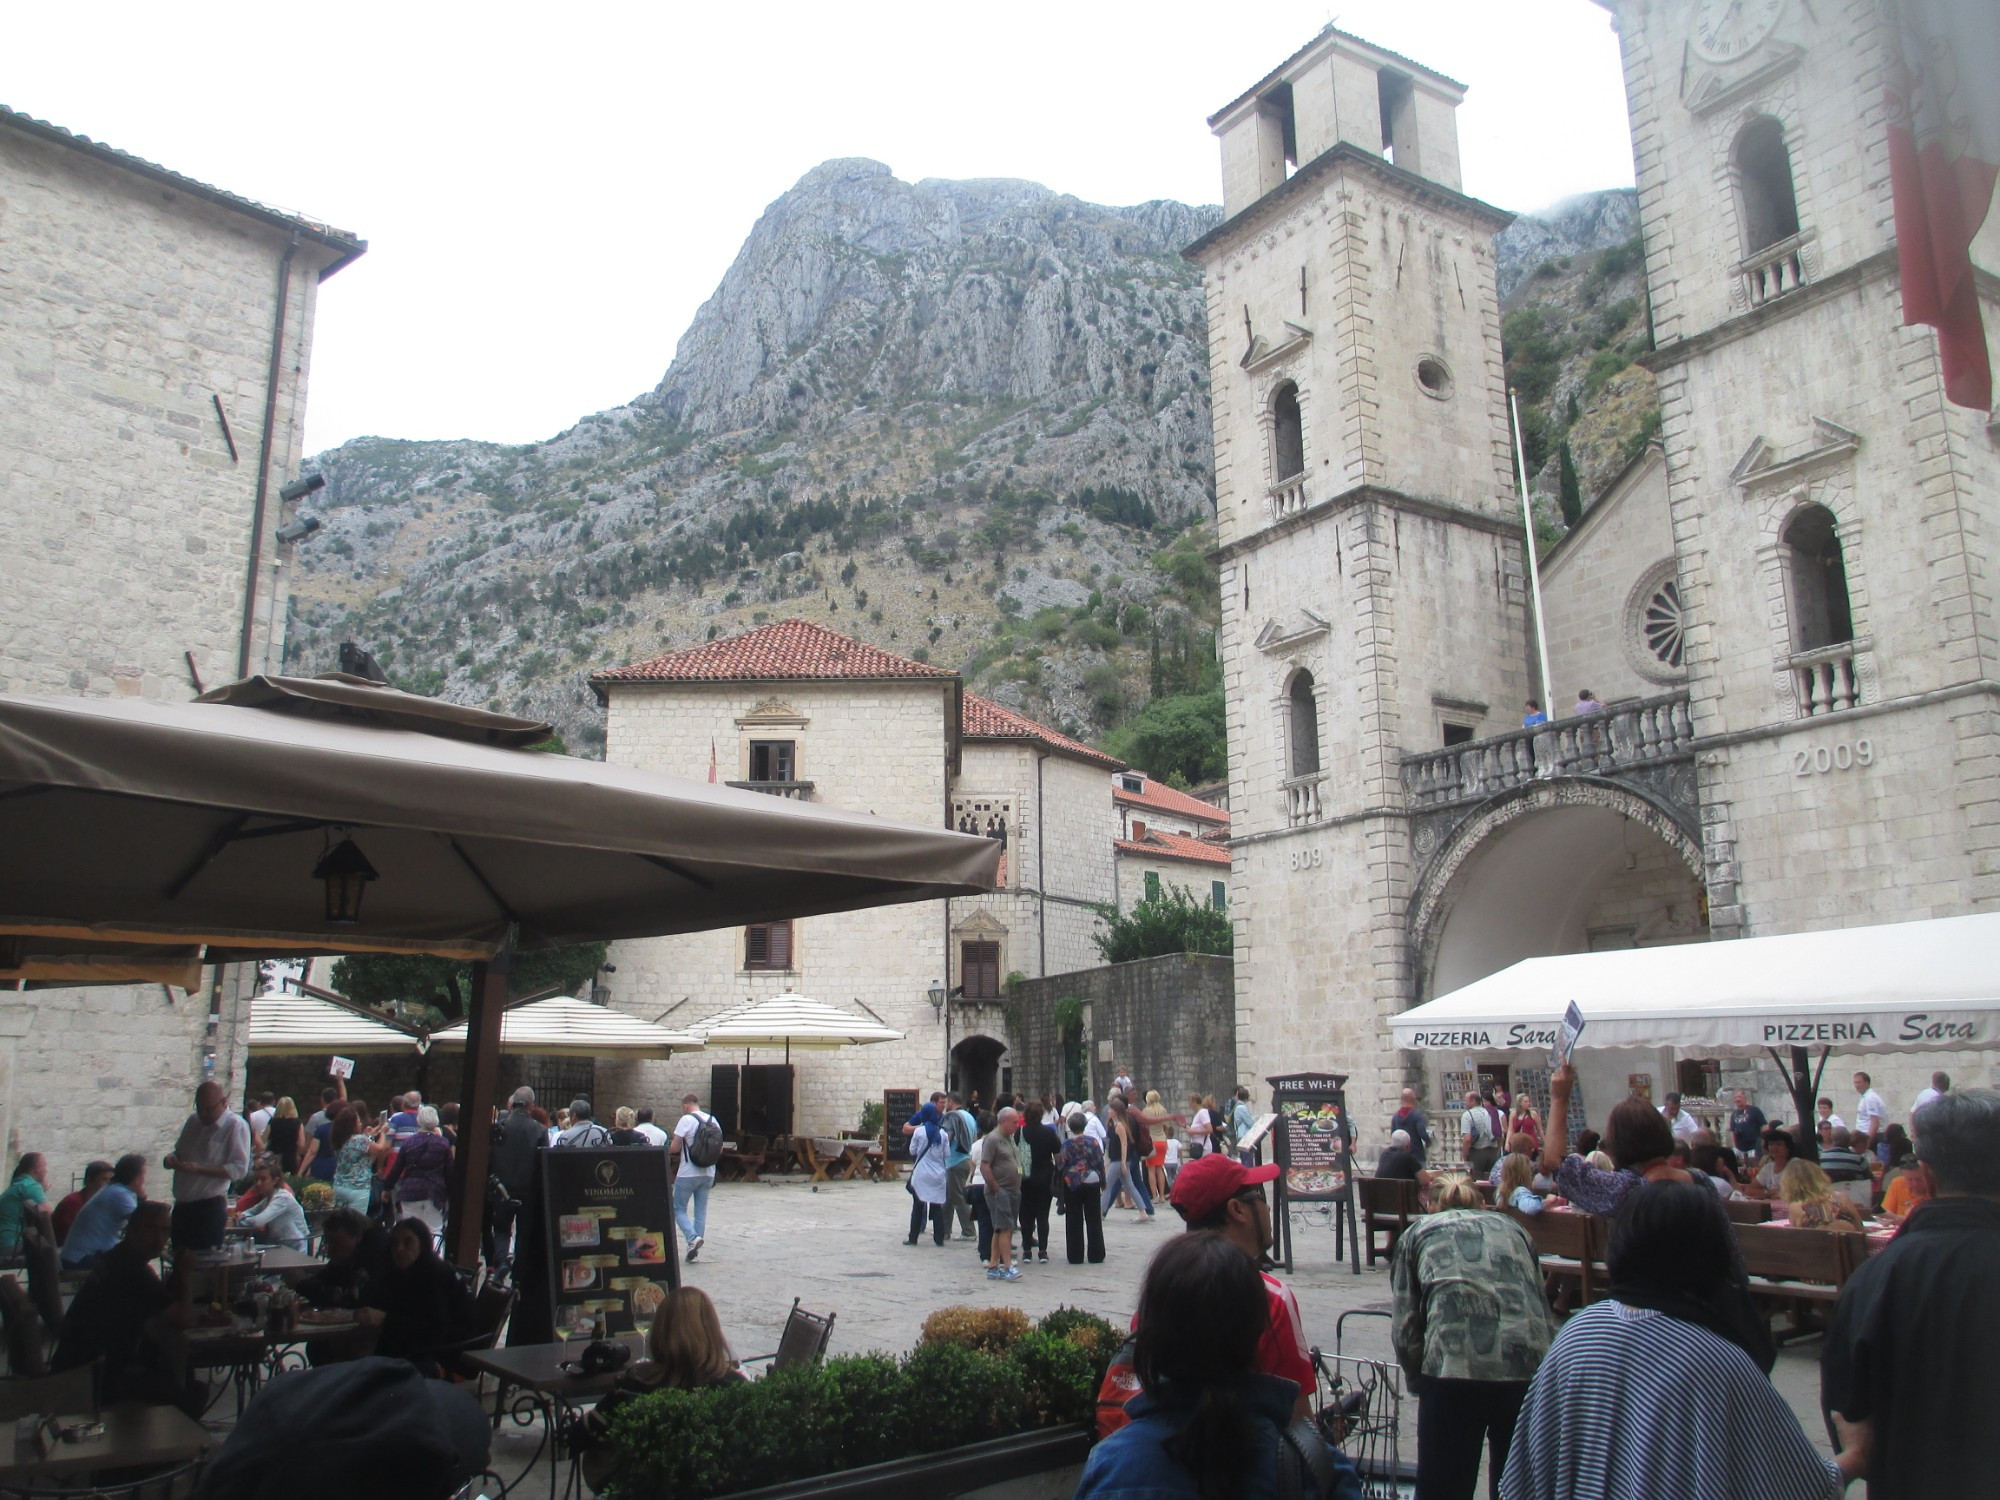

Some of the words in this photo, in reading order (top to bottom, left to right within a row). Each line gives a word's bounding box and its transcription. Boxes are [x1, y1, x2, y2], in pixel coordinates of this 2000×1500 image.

[1792, 738, 1874, 777] 2009
[1290, 847, 1322, 871] 809
[1413, 1031, 1491, 1046] PIZZERIA
[1506, 1023, 1556, 1046] Sara
[1763, 1022, 1876, 1041] PIZZERIA
[1898, 1013, 1977, 1041] Sara
[1279, 1080, 1305, 1090] FREE
[1308, 1080, 1336, 1089] WI-FI
[584, 1187, 634, 1196] VINOMANIA
